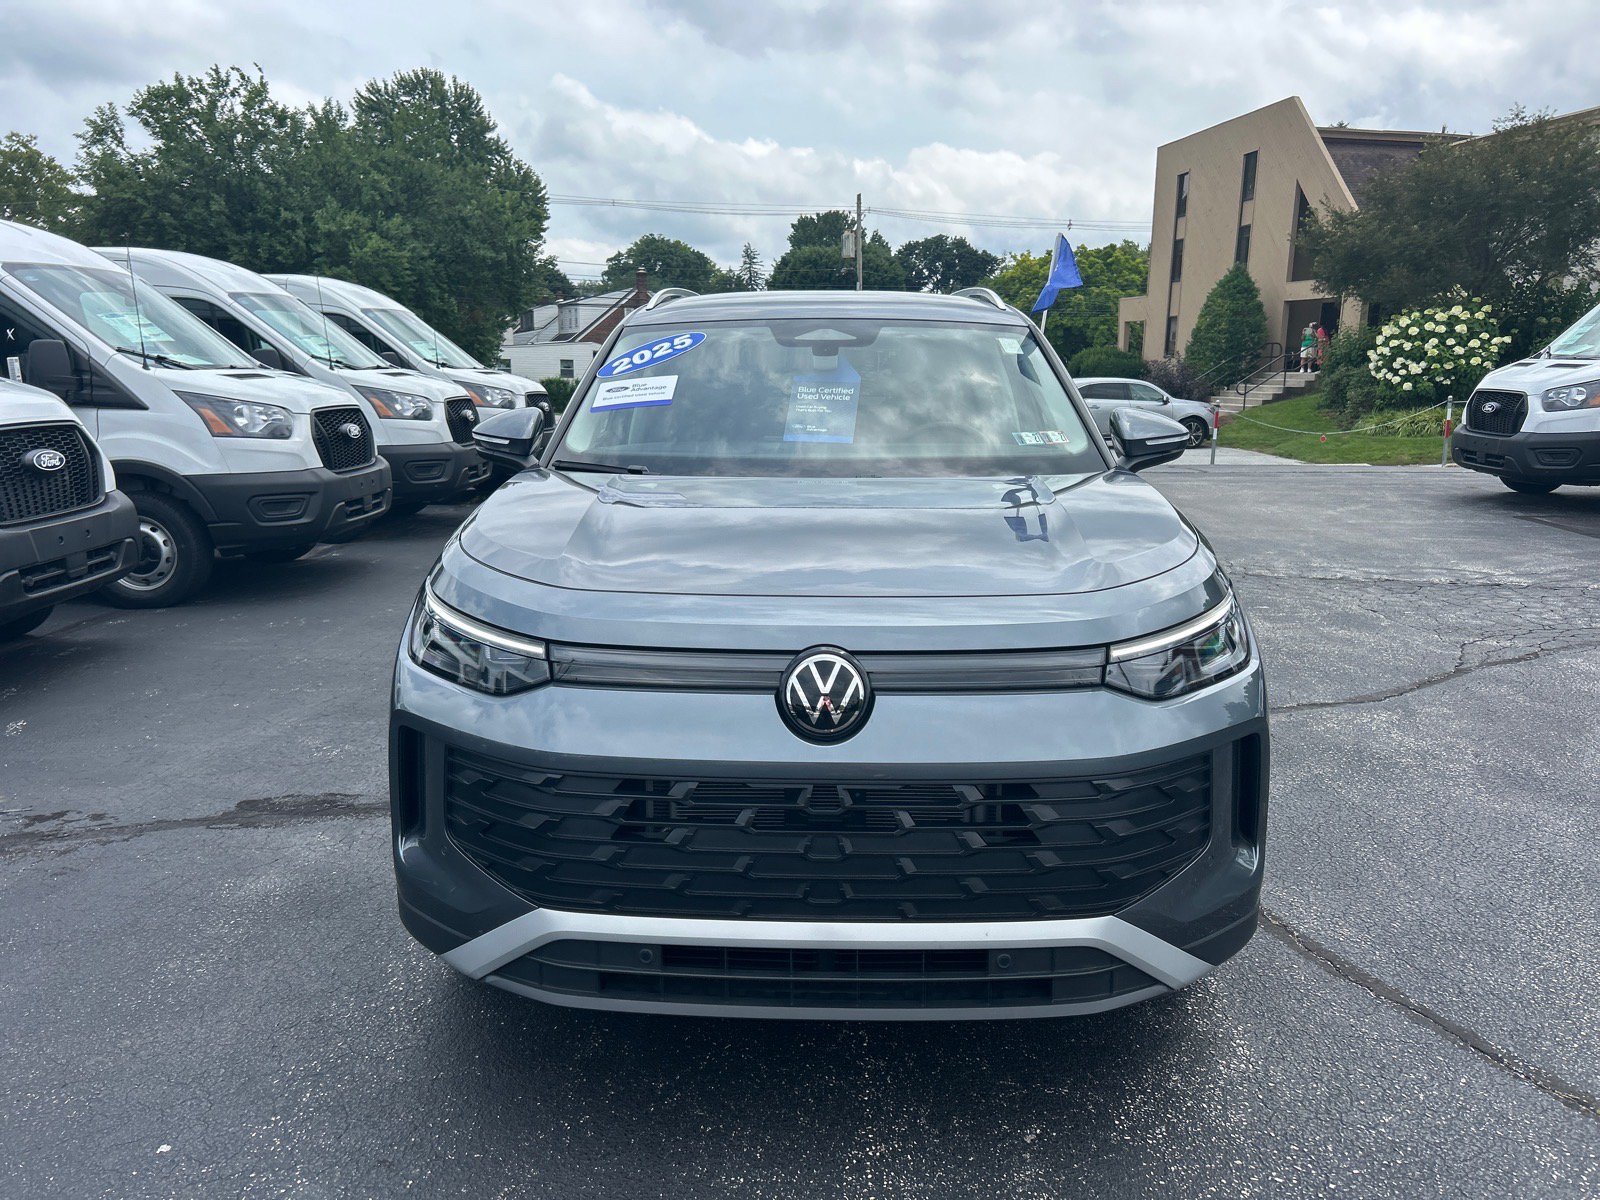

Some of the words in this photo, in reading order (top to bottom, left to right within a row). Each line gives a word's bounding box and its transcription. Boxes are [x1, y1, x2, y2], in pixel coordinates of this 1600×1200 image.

[612, 334, 693, 375] 2025
[818, 386, 854, 395] Certified
[820, 393, 851, 401] Vehicle
[40, 453, 61, 467] Ford
